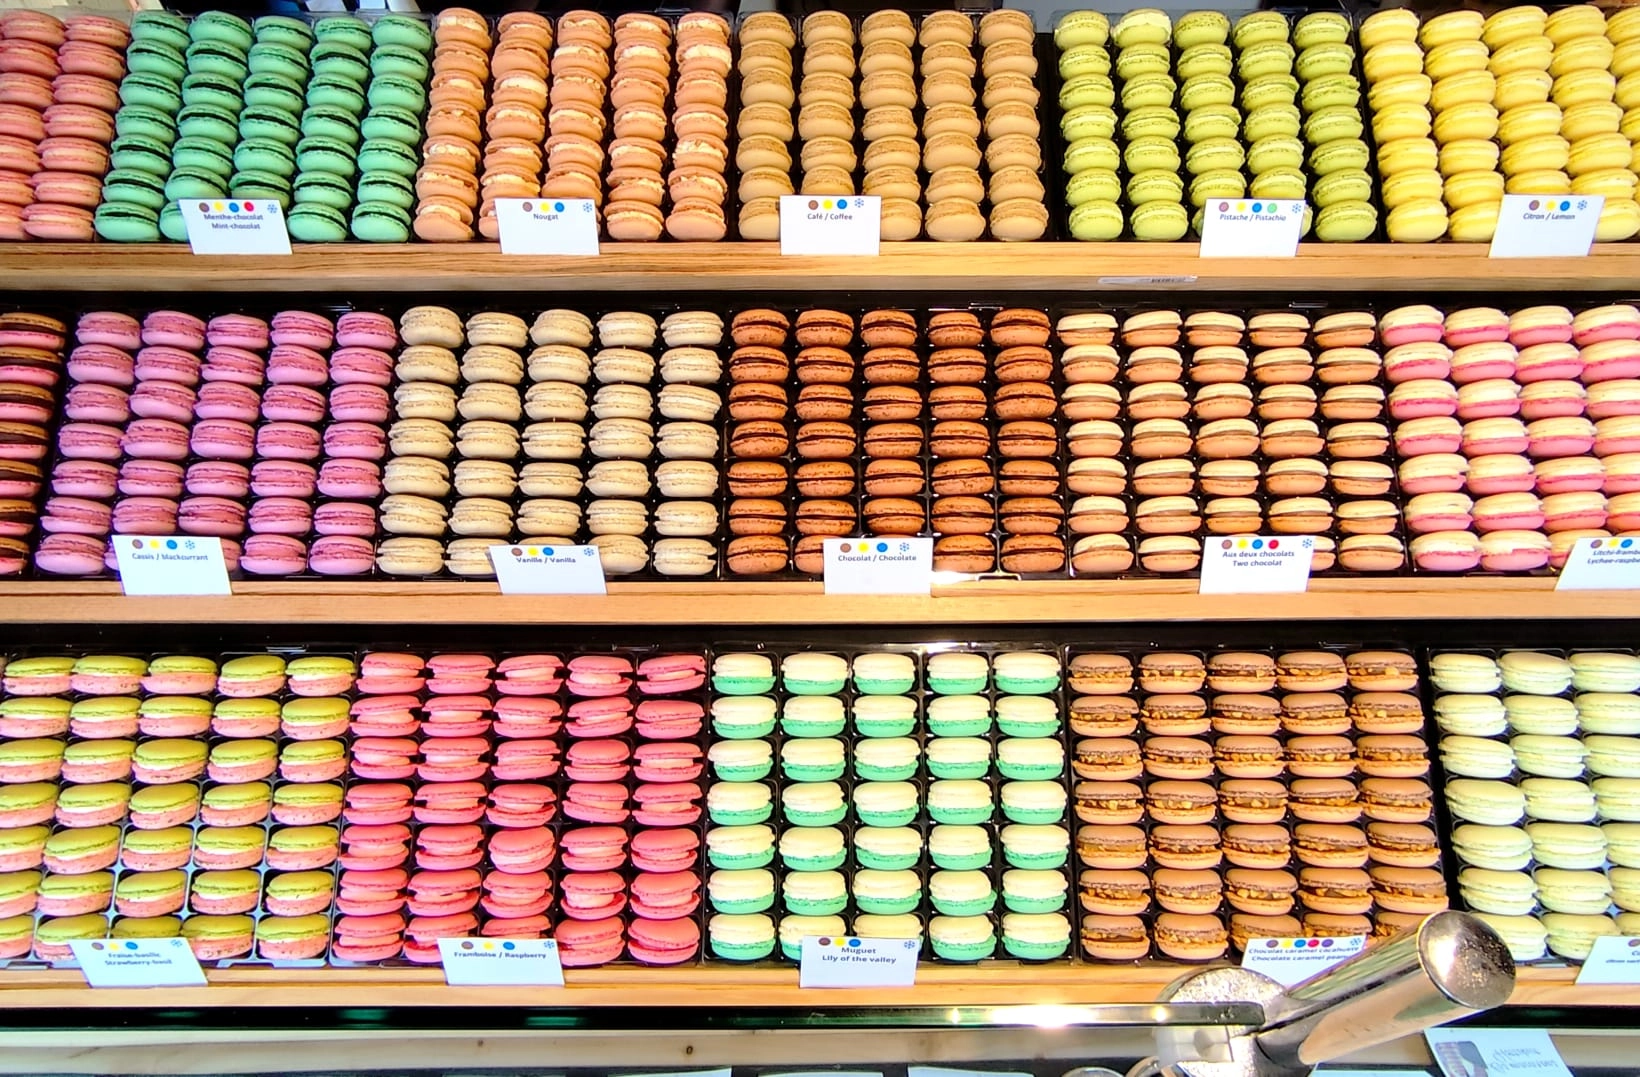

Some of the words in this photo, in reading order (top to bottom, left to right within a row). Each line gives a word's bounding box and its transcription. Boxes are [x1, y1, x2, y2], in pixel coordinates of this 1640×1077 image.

[533, 213, 559, 221] Nougat
[1219, 213, 1248, 221] Pistache
[838, 554, 871, 562] Chocolat
[841, 947, 877, 955] Muguet
[505, 952, 547, 960] Raspberry
[869, 956, 897, 964] valley
